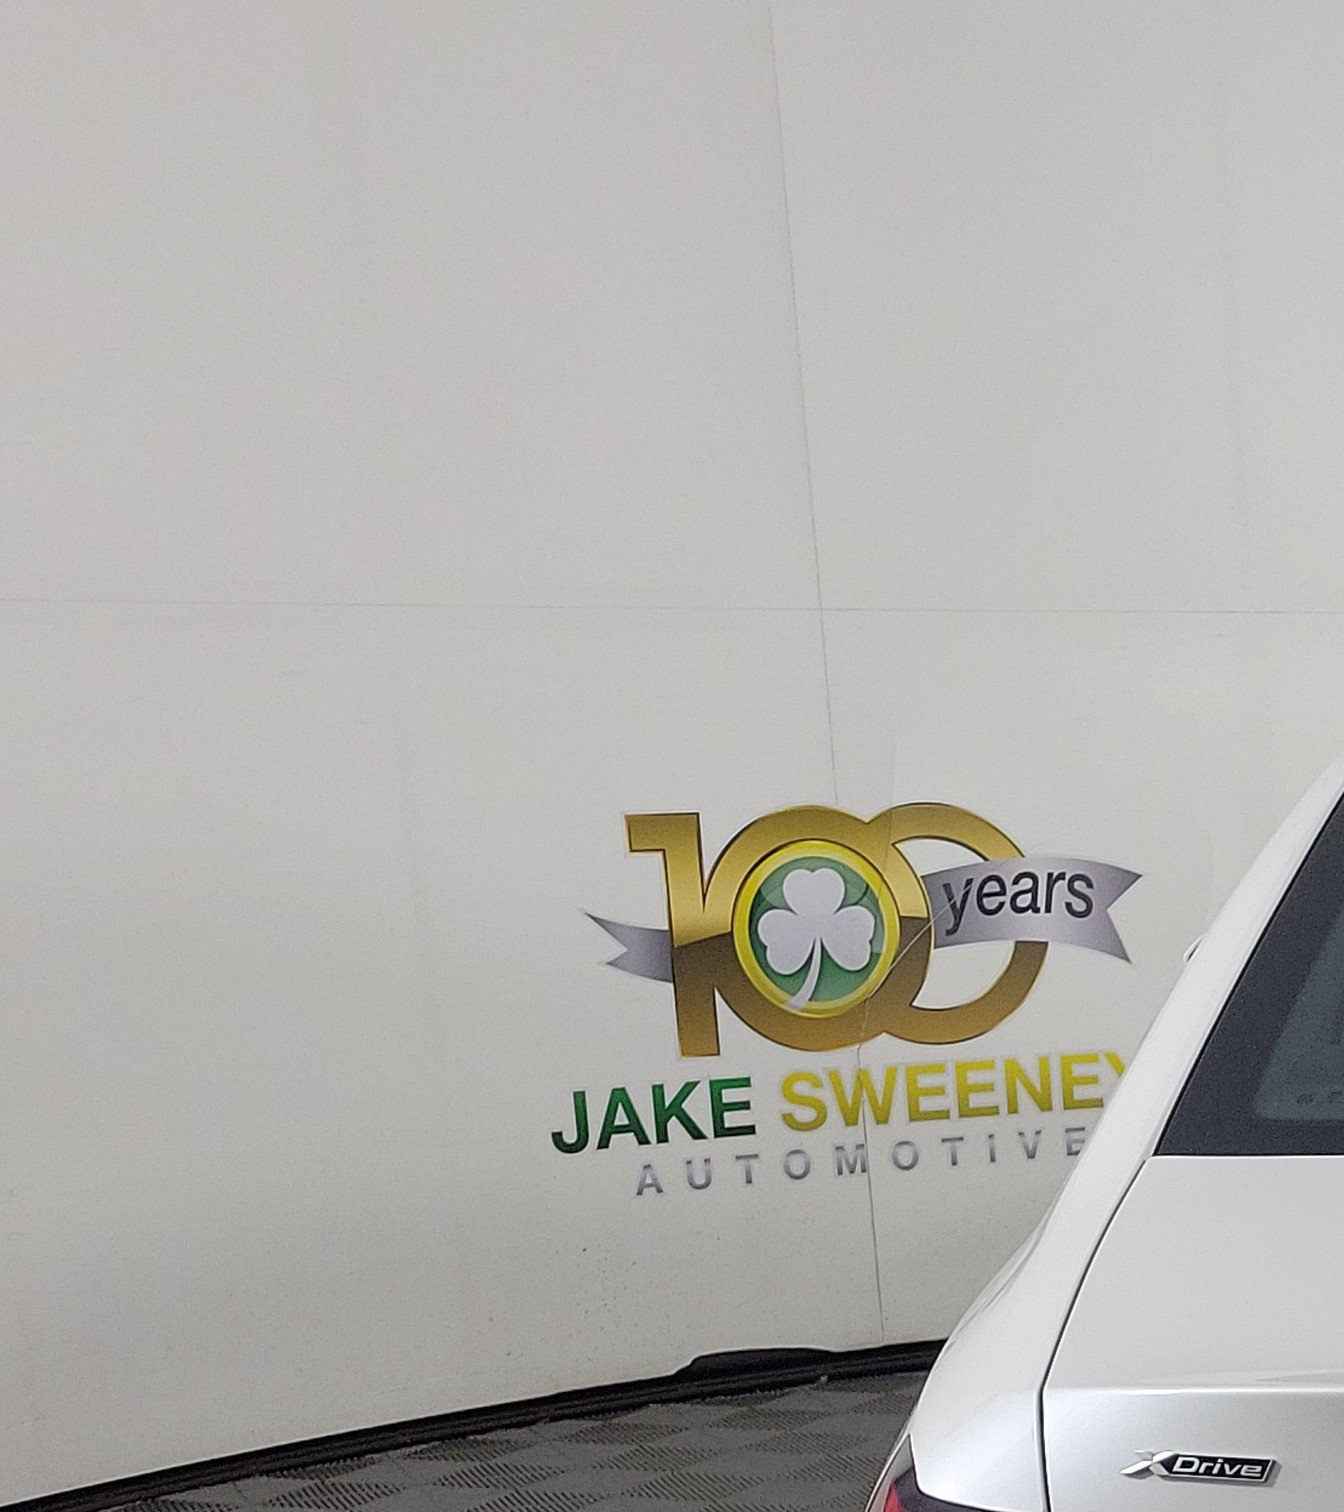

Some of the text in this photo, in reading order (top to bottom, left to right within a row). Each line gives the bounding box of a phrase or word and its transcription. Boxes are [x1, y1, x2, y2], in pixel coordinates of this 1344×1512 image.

[624, 802, 1095, 1057] 100 years
[550, 1076, 757, 1156] JAKE
[635, 1126, 1087, 1197] AUTOMOTIVE
